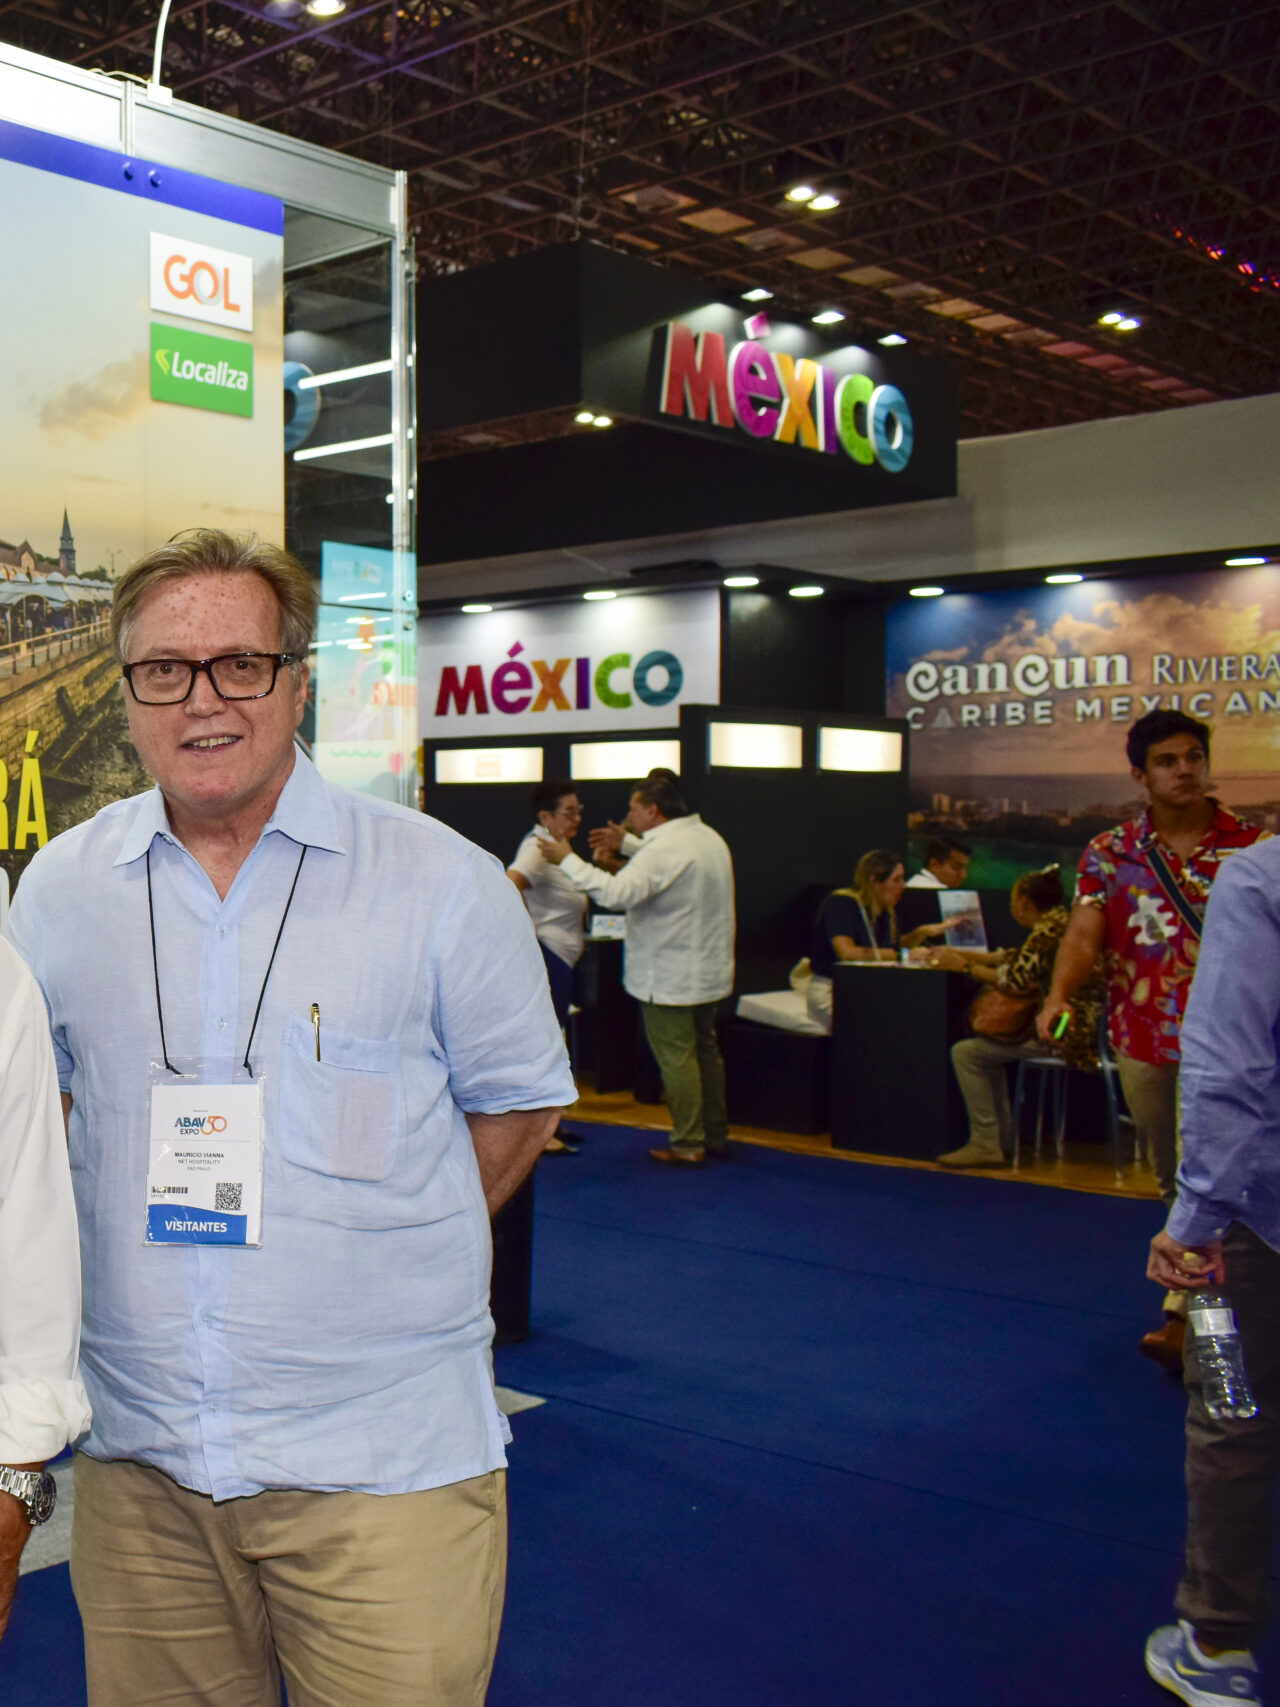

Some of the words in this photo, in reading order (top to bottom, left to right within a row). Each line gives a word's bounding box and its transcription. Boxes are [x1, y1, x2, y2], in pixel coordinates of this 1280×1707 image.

[163, 254, 240, 312] GOL
[172, 351, 249, 391] Localiza
[165, 1220, 228, 1233] VISITANTES
